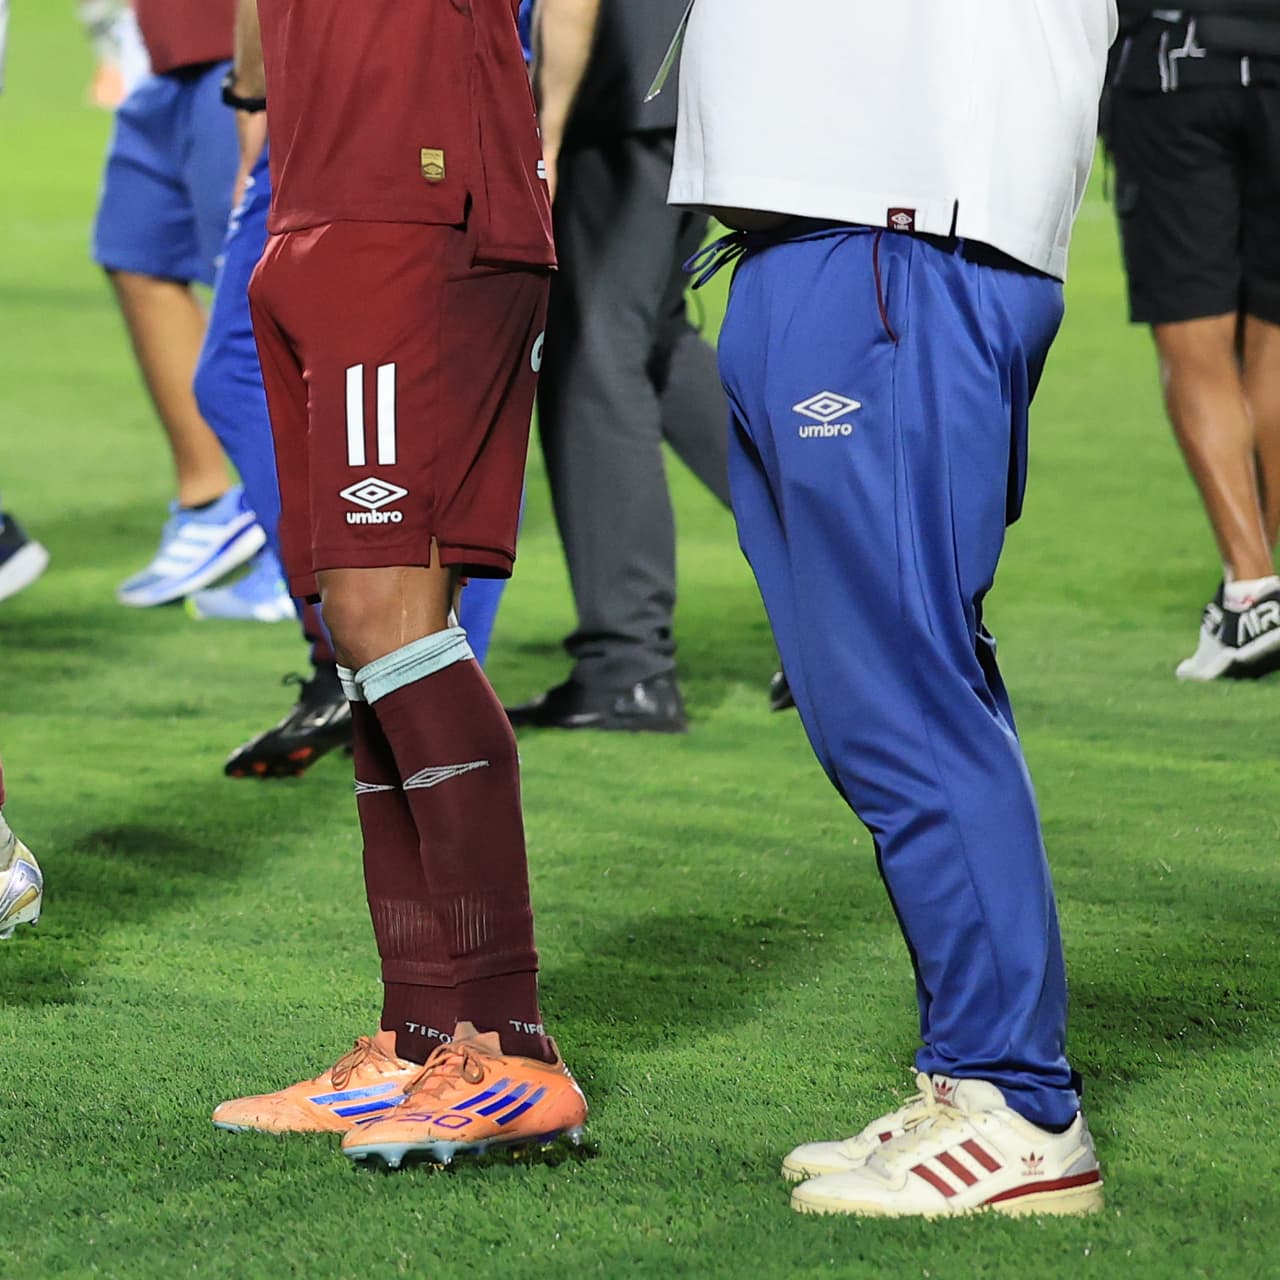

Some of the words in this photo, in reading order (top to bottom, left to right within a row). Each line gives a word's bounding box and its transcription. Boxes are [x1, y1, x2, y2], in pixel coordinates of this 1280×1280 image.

[346, 363, 397, 466] 11
[798, 422, 853, 438] umbro
[346, 508, 403, 524] umbro
